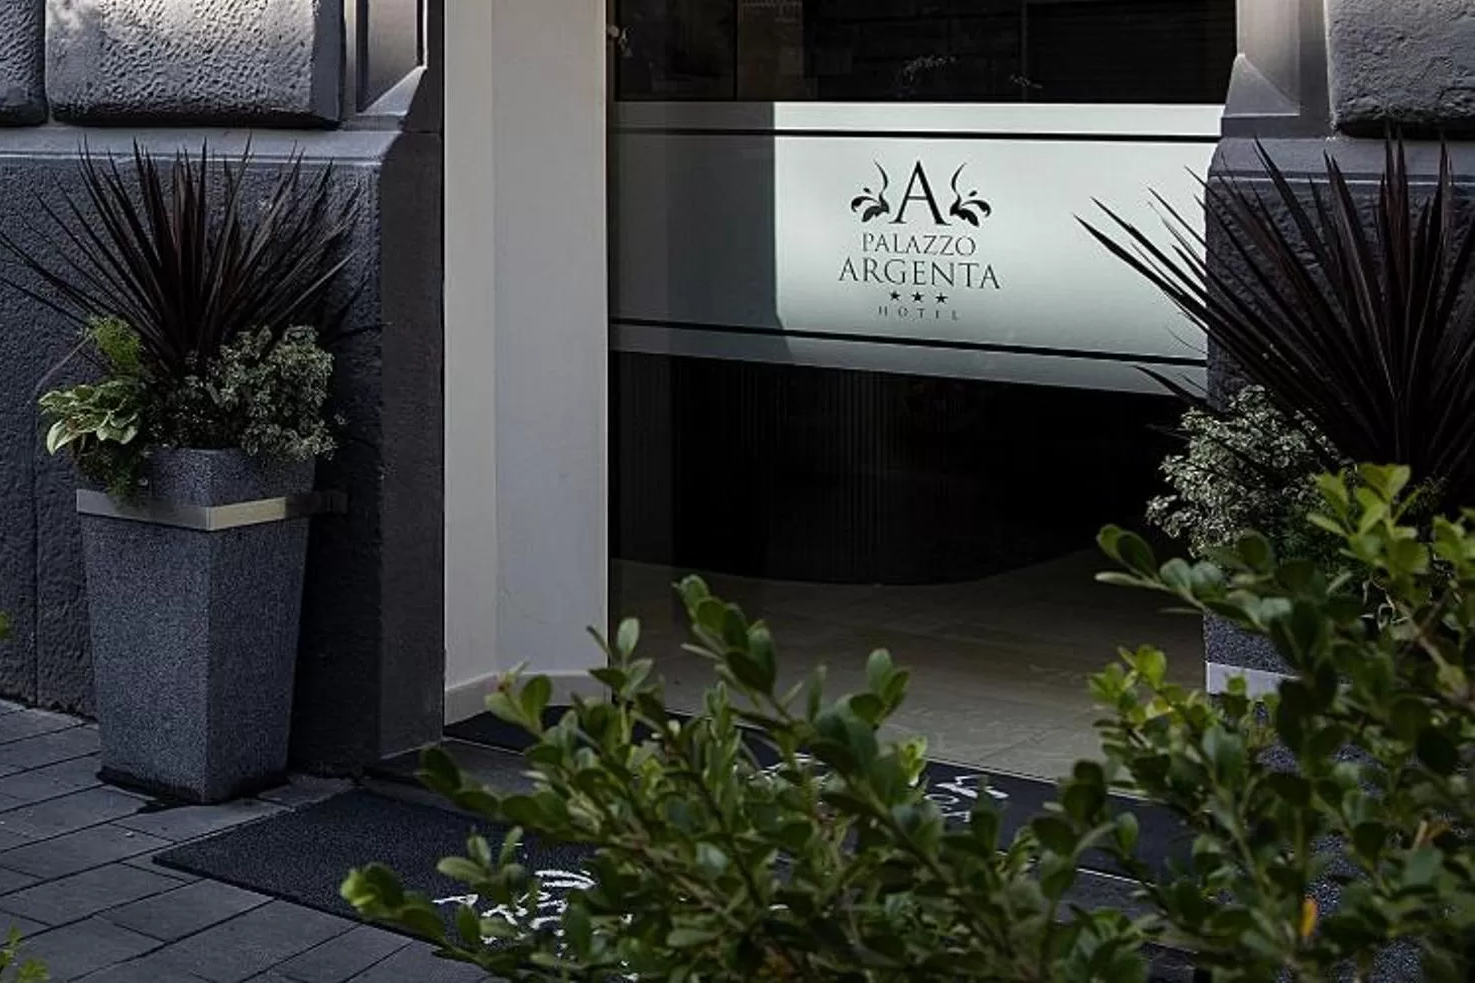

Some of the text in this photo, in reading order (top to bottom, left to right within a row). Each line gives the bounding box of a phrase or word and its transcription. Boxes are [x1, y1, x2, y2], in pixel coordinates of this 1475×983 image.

[888, 160, 952, 226] A
[862, 232, 976, 256] PALAZZO
[838, 256, 1001, 290] ARGENTA
